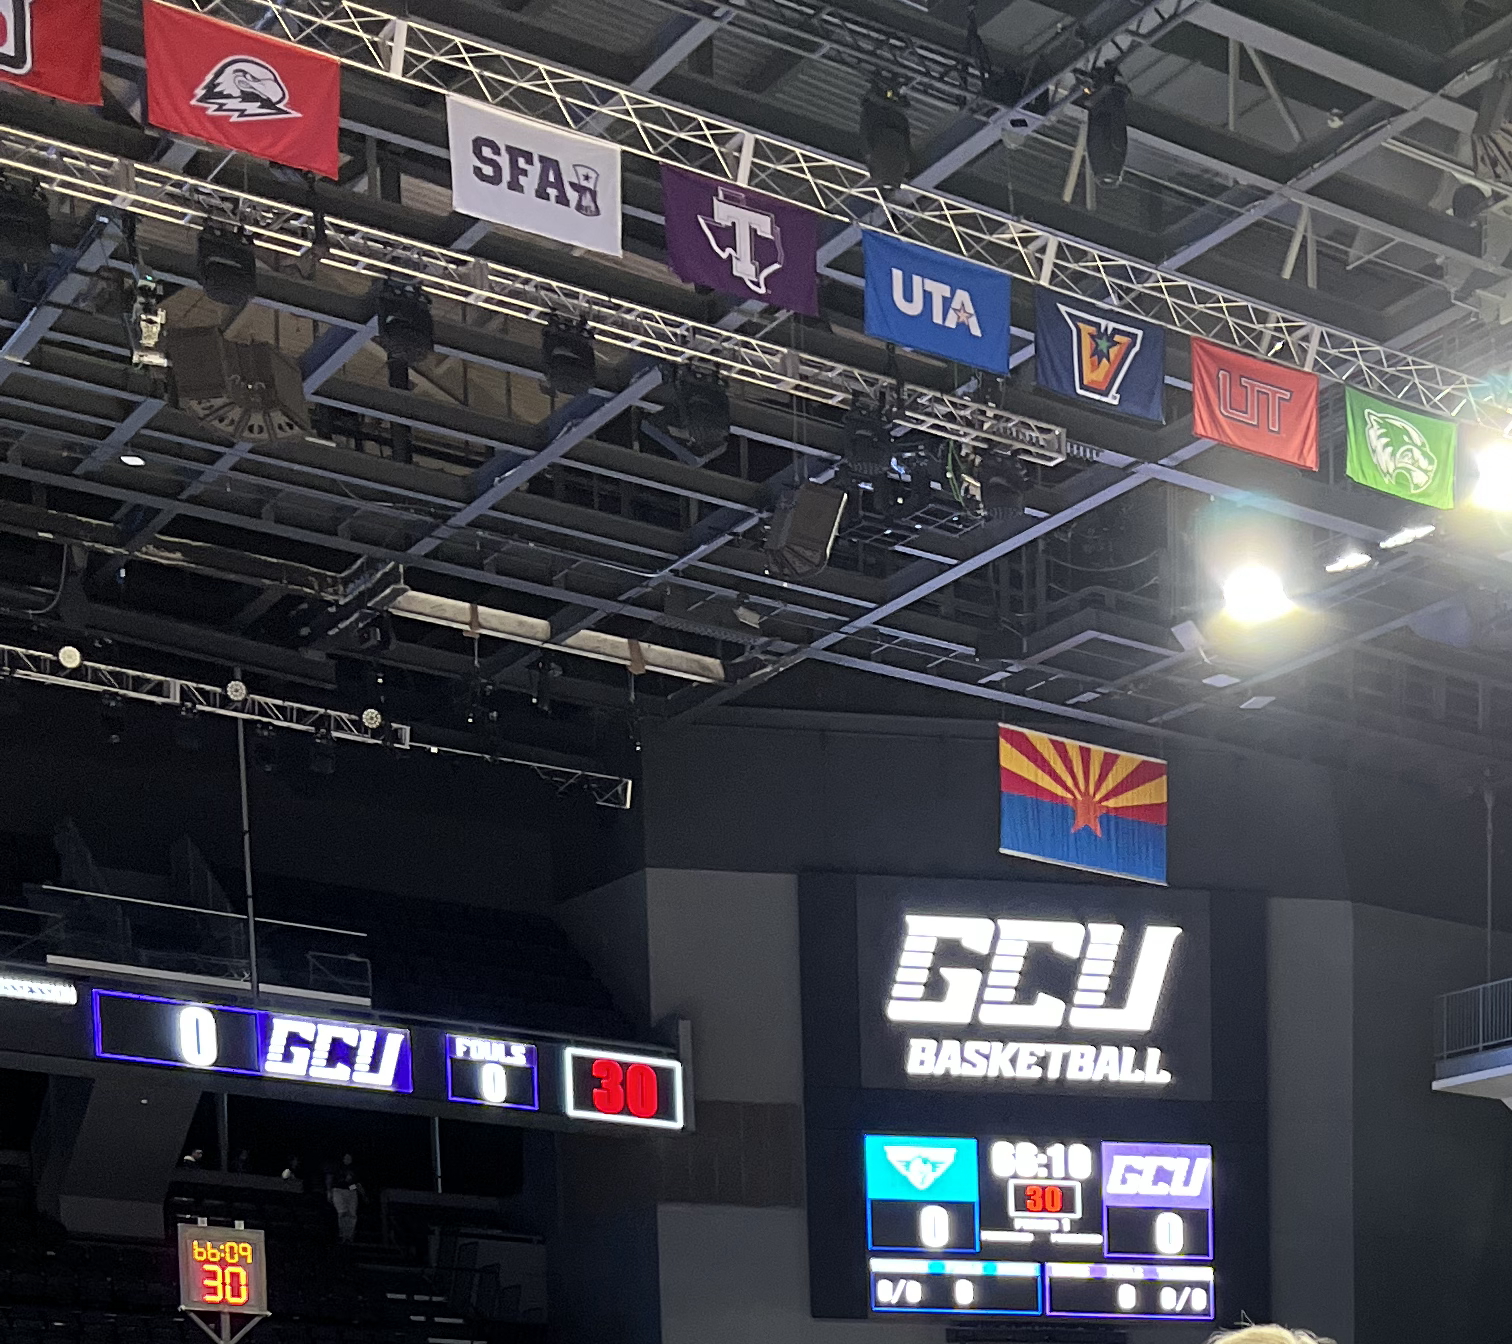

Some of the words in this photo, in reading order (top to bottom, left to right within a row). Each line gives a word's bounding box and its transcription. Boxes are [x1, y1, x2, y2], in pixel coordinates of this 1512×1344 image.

[471, 135, 571, 208] SFA
[891, 267, 983, 339] UTA
[1216, 369, 1293, 435] UT
[885, 913, 1184, 1032] GCU
[180, 1005, 218, 1067] 0
[263, 1017, 405, 1089] GCU
[455, 1037, 526, 1065] FOULS
[906, 1037, 1172, 1085] BASKETBALL
[481, 1062, 507, 1103] 0
[592, 1059, 658, 1118] 30
[1025, 1185, 1063, 1213] 30
[1106, 1154, 1211, 1198] GCU
[192, 1240, 253, 1264] 66:09
[919, 1204, 950, 1249] 0
[1154, 1211, 1185, 1255] 0
[203, 1264, 249, 1306] 30
